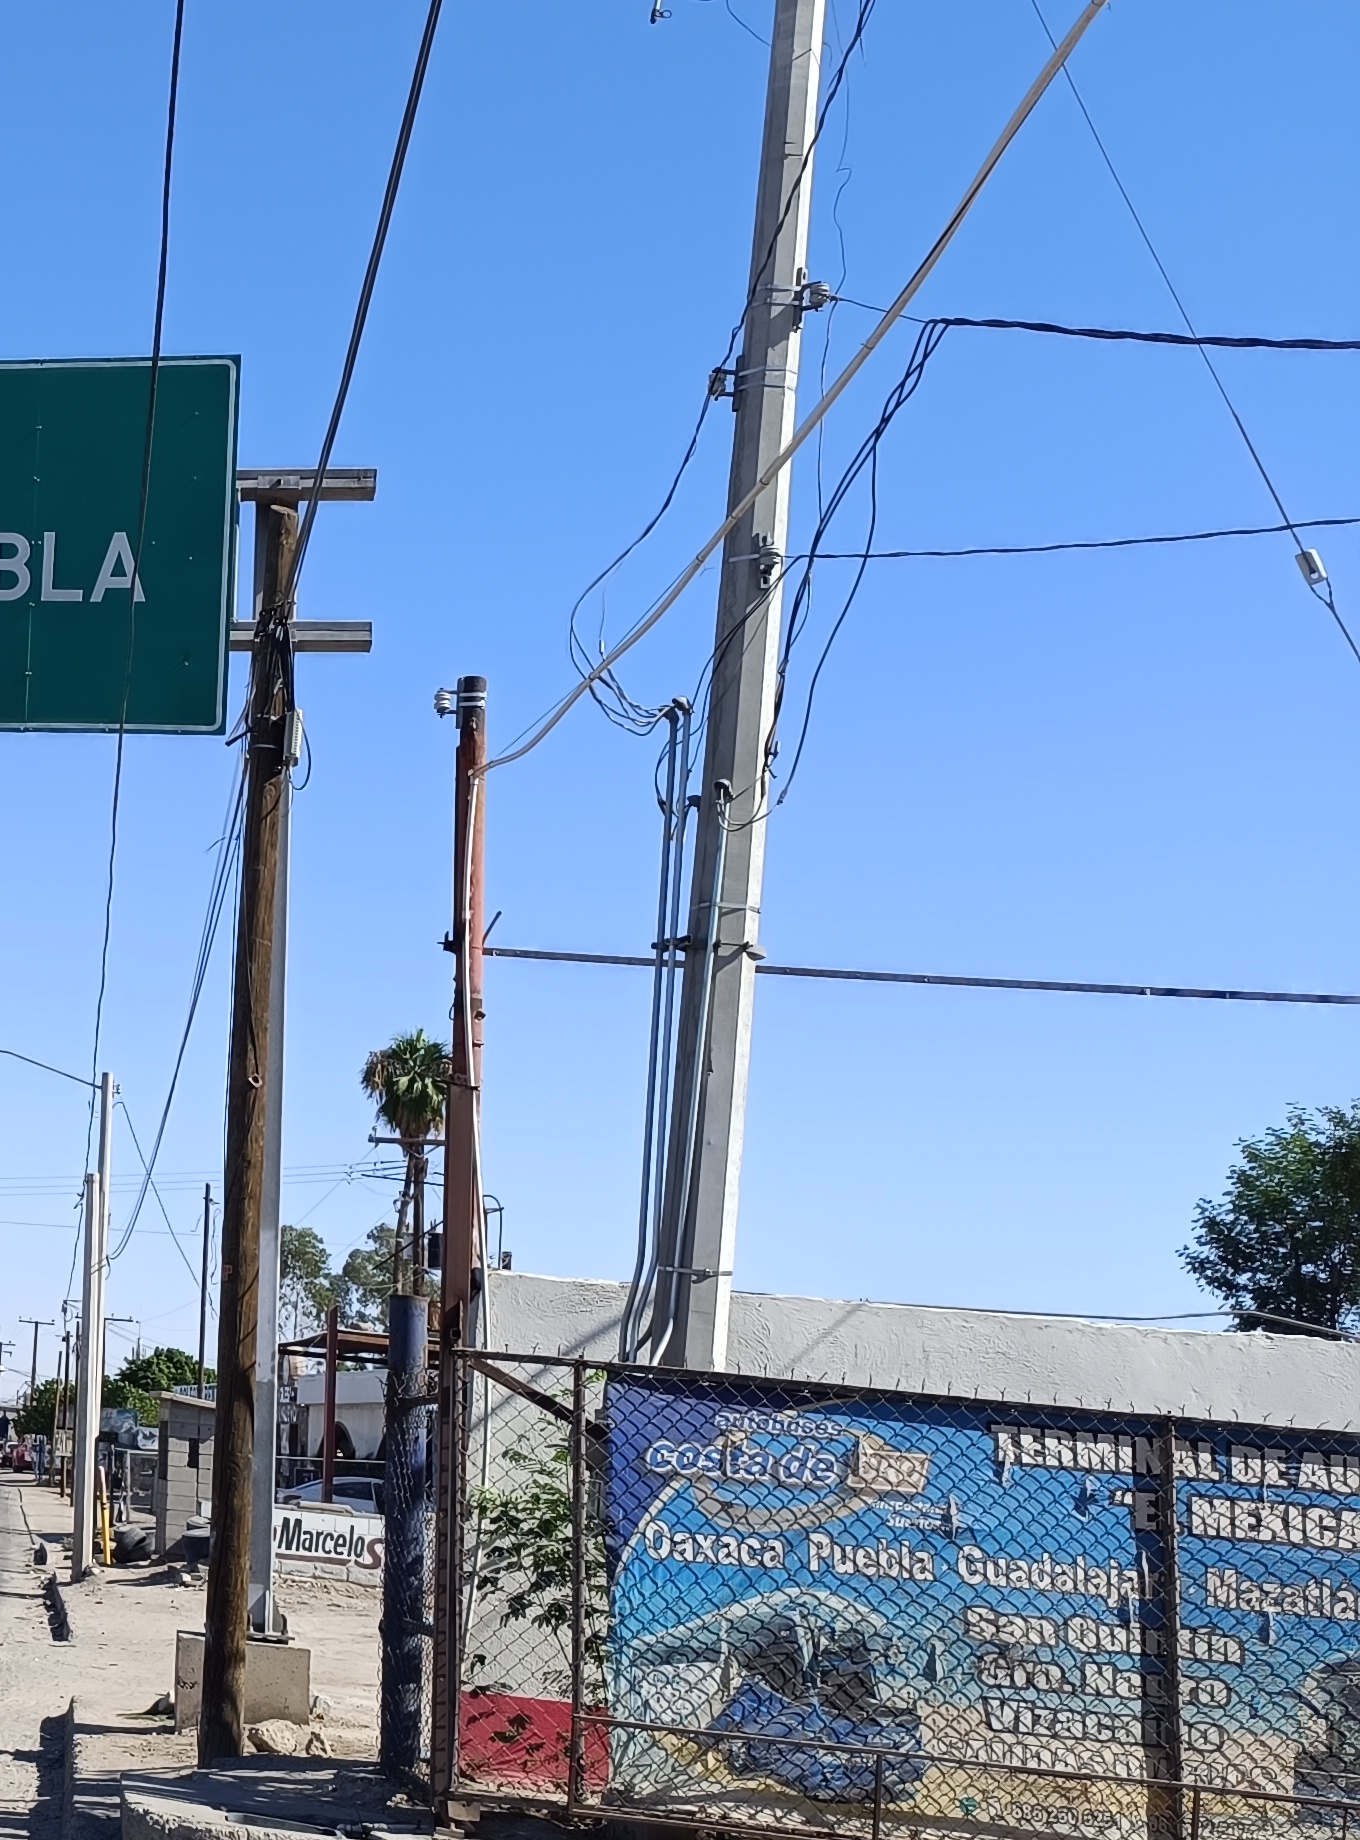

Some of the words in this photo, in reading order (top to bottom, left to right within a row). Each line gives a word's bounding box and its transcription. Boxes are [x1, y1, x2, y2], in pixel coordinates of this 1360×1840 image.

[644, 1439, 774, 1481] costa
[780, 1444, 839, 1485] de
[1230, 1445, 1289, 1487] DE
[643, 1520, 785, 1569] Oaxaca
[807, 1532, 934, 1580] Puebla
